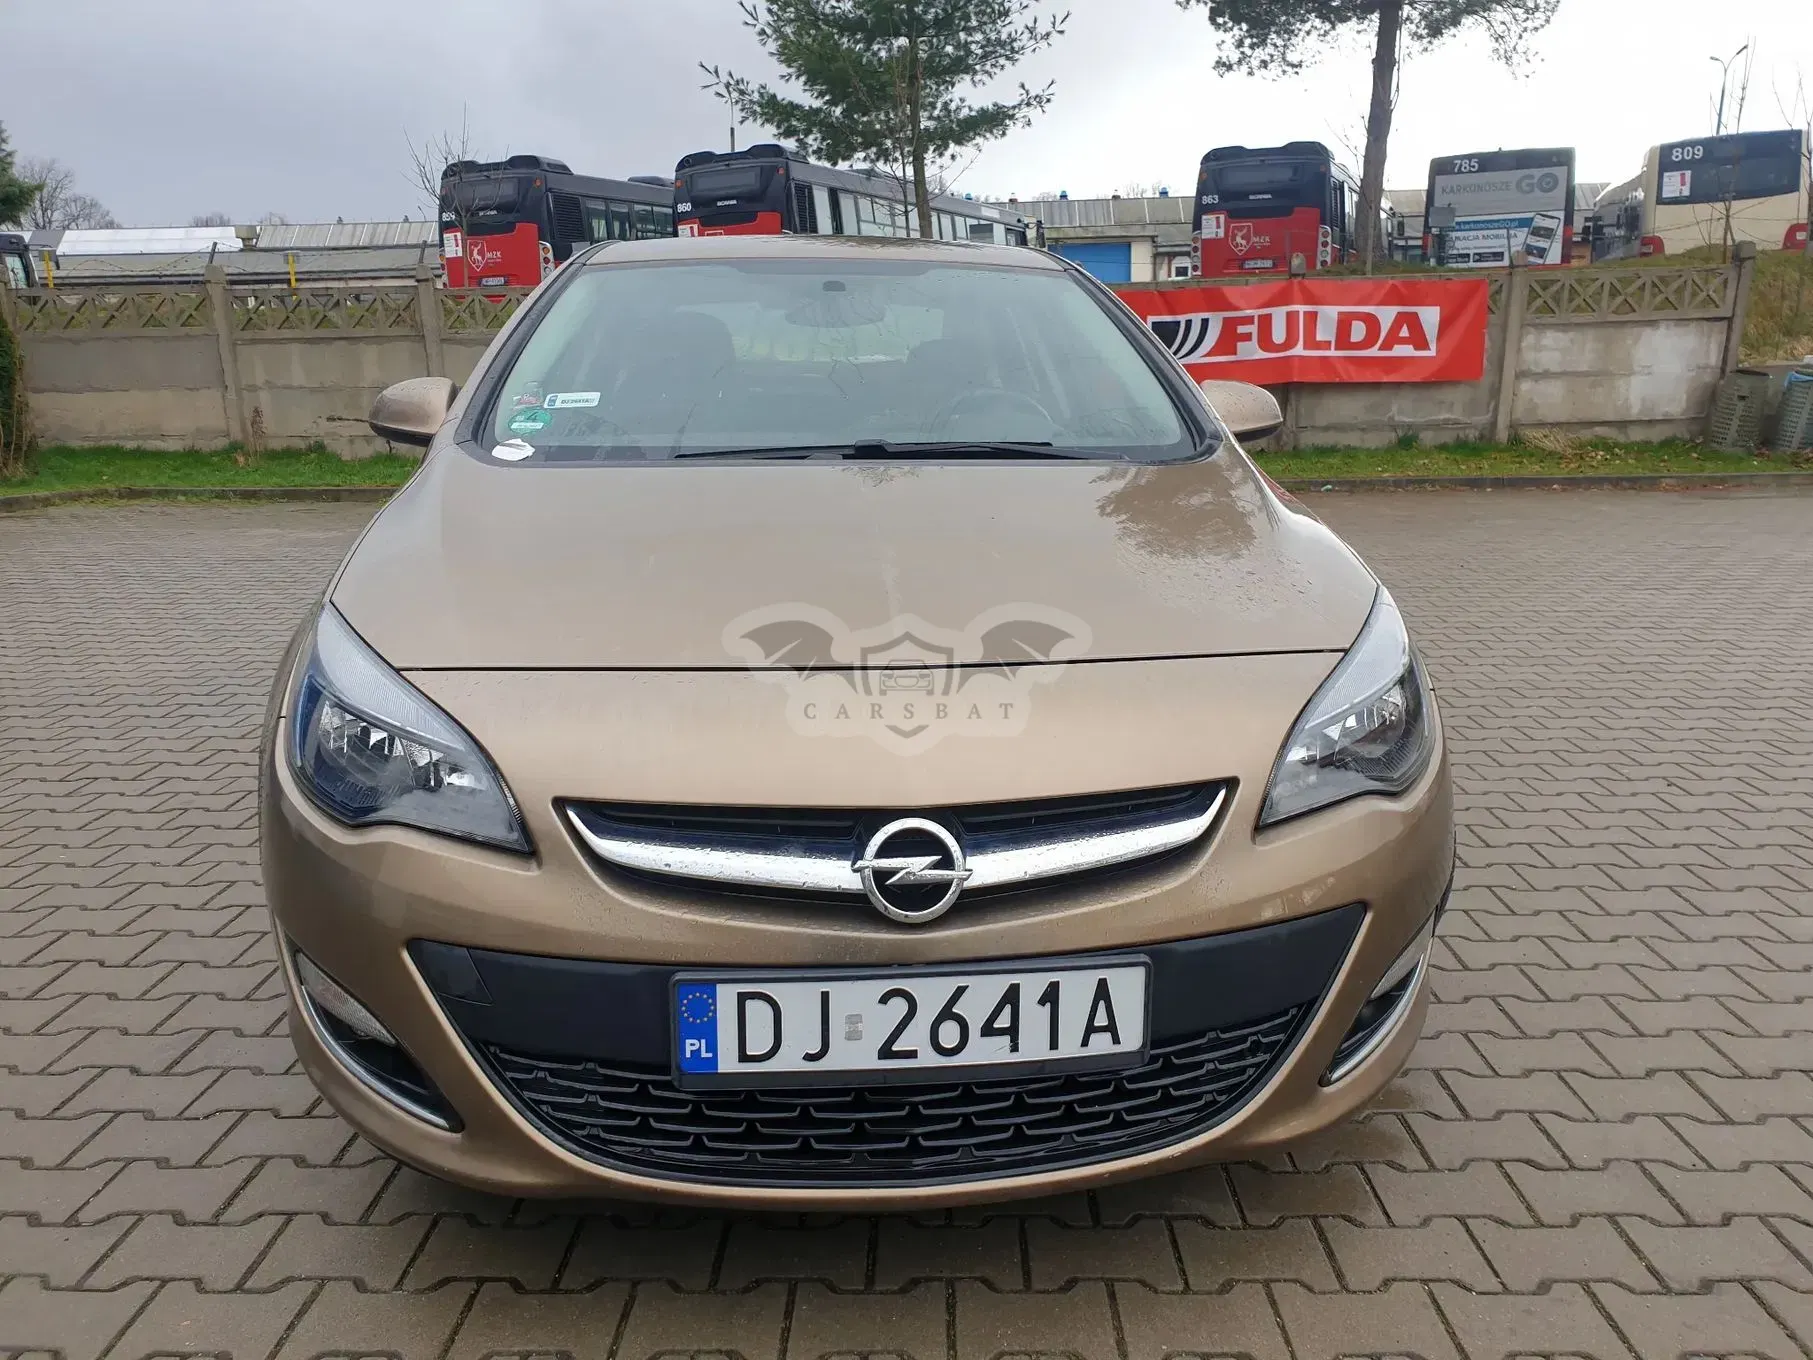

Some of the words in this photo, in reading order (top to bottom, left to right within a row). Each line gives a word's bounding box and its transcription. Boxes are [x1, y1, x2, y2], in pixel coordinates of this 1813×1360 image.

[1671, 145, 1704, 162] 809
[1453, 158, 1479, 173] 785
[1515, 172, 1559, 194] GO
[677, 202, 692, 213] 860
[1201, 194, 1219, 205] 863
[487, 250, 502, 259] MZK
[1202, 310, 1433, 358] FULDA
[685, 1038, 713, 1059] PL
[736, 989, 831, 1064] DJ
[876, 976, 1122, 1061] 2641A
